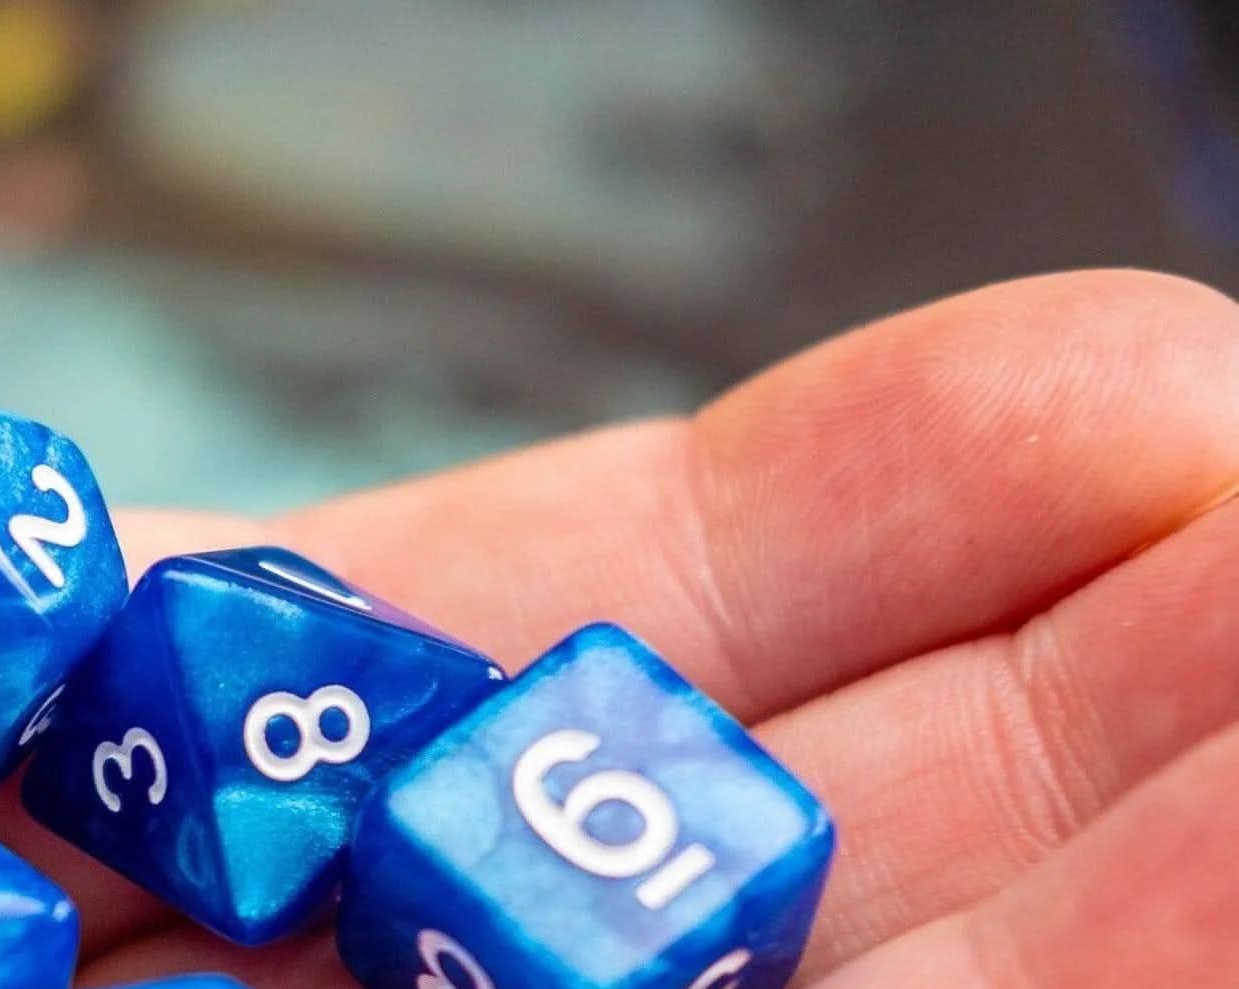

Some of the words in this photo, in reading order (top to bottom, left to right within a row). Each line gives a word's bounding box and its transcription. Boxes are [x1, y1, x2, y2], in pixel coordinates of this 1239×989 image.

[8, 464, 87, 588] 2
[92, 726, 168, 813] 3
[243, 684, 371, 782] 8
